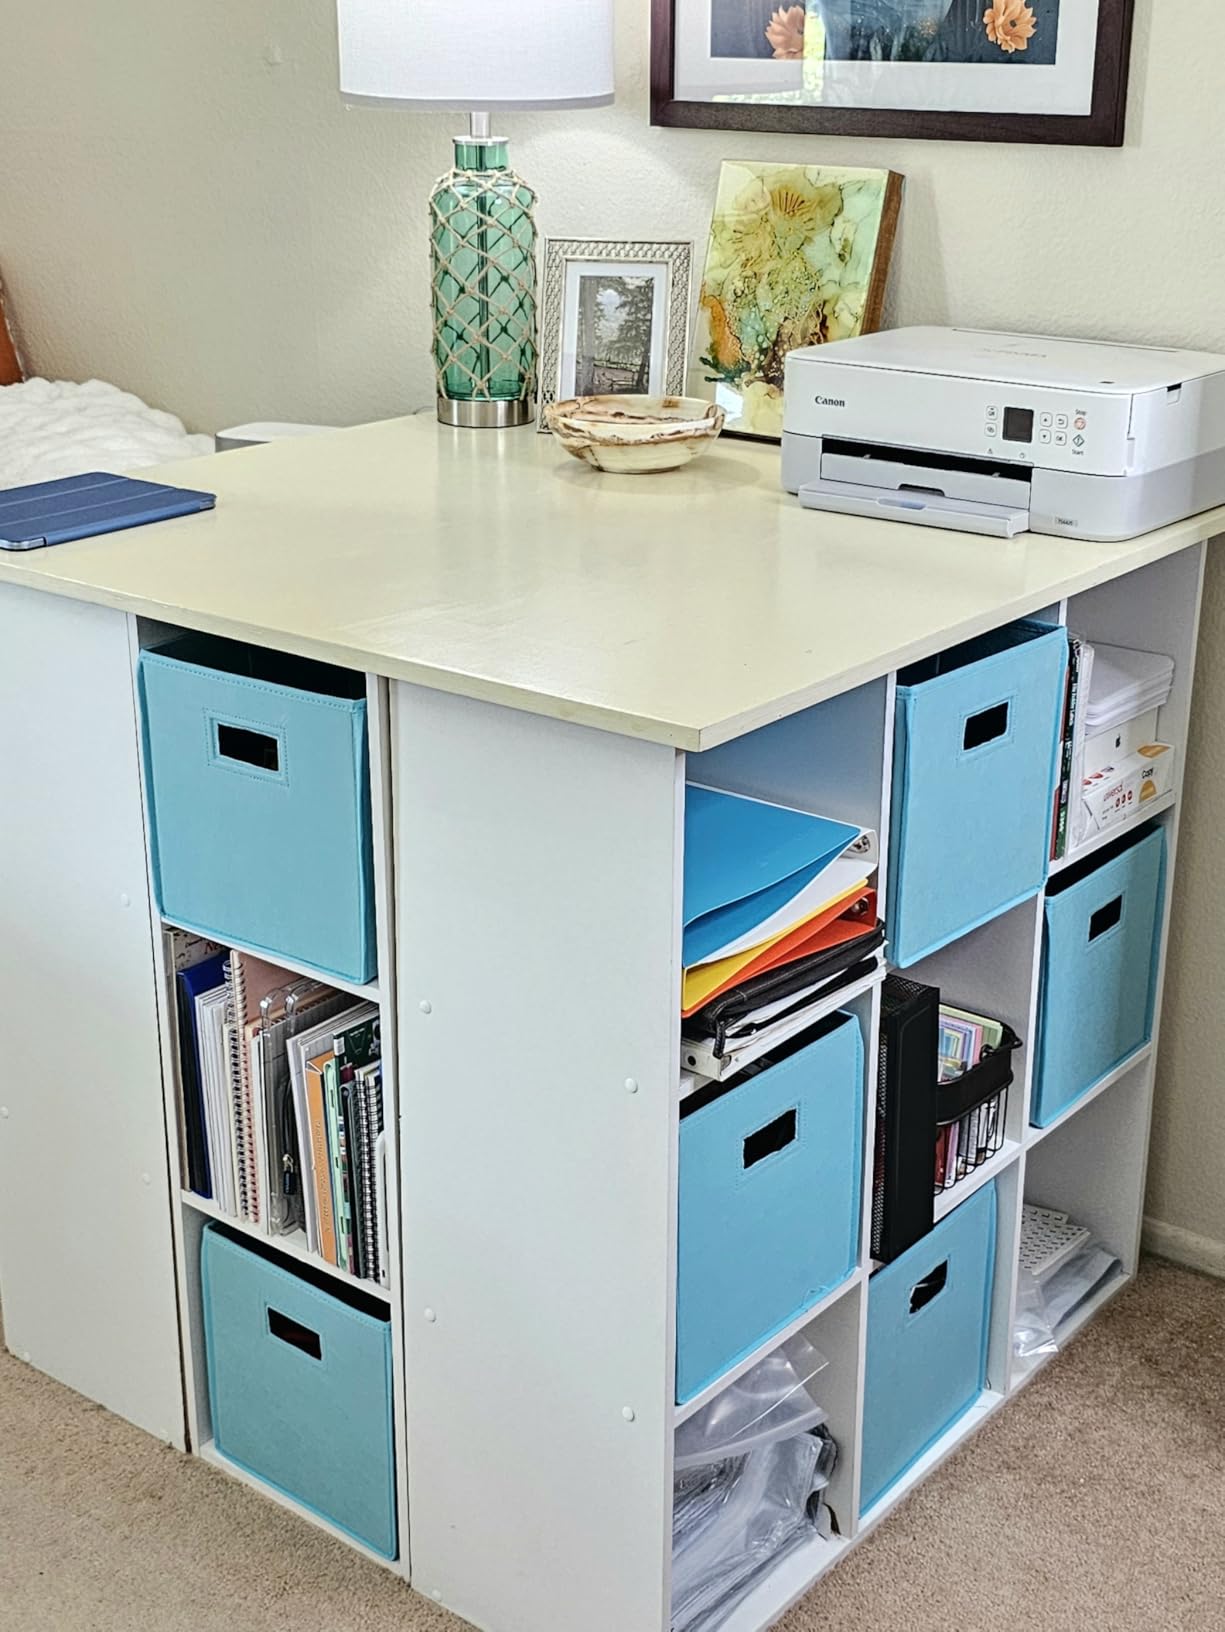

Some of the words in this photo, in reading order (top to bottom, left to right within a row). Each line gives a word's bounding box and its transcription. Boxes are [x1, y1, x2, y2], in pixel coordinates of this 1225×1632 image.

[814, 395, 846, 408] Canon
[1075, 408, 1087, 416] Stop
[1071, 448, 1084, 456] Start
[1141, 767, 1154, 779] Copy
